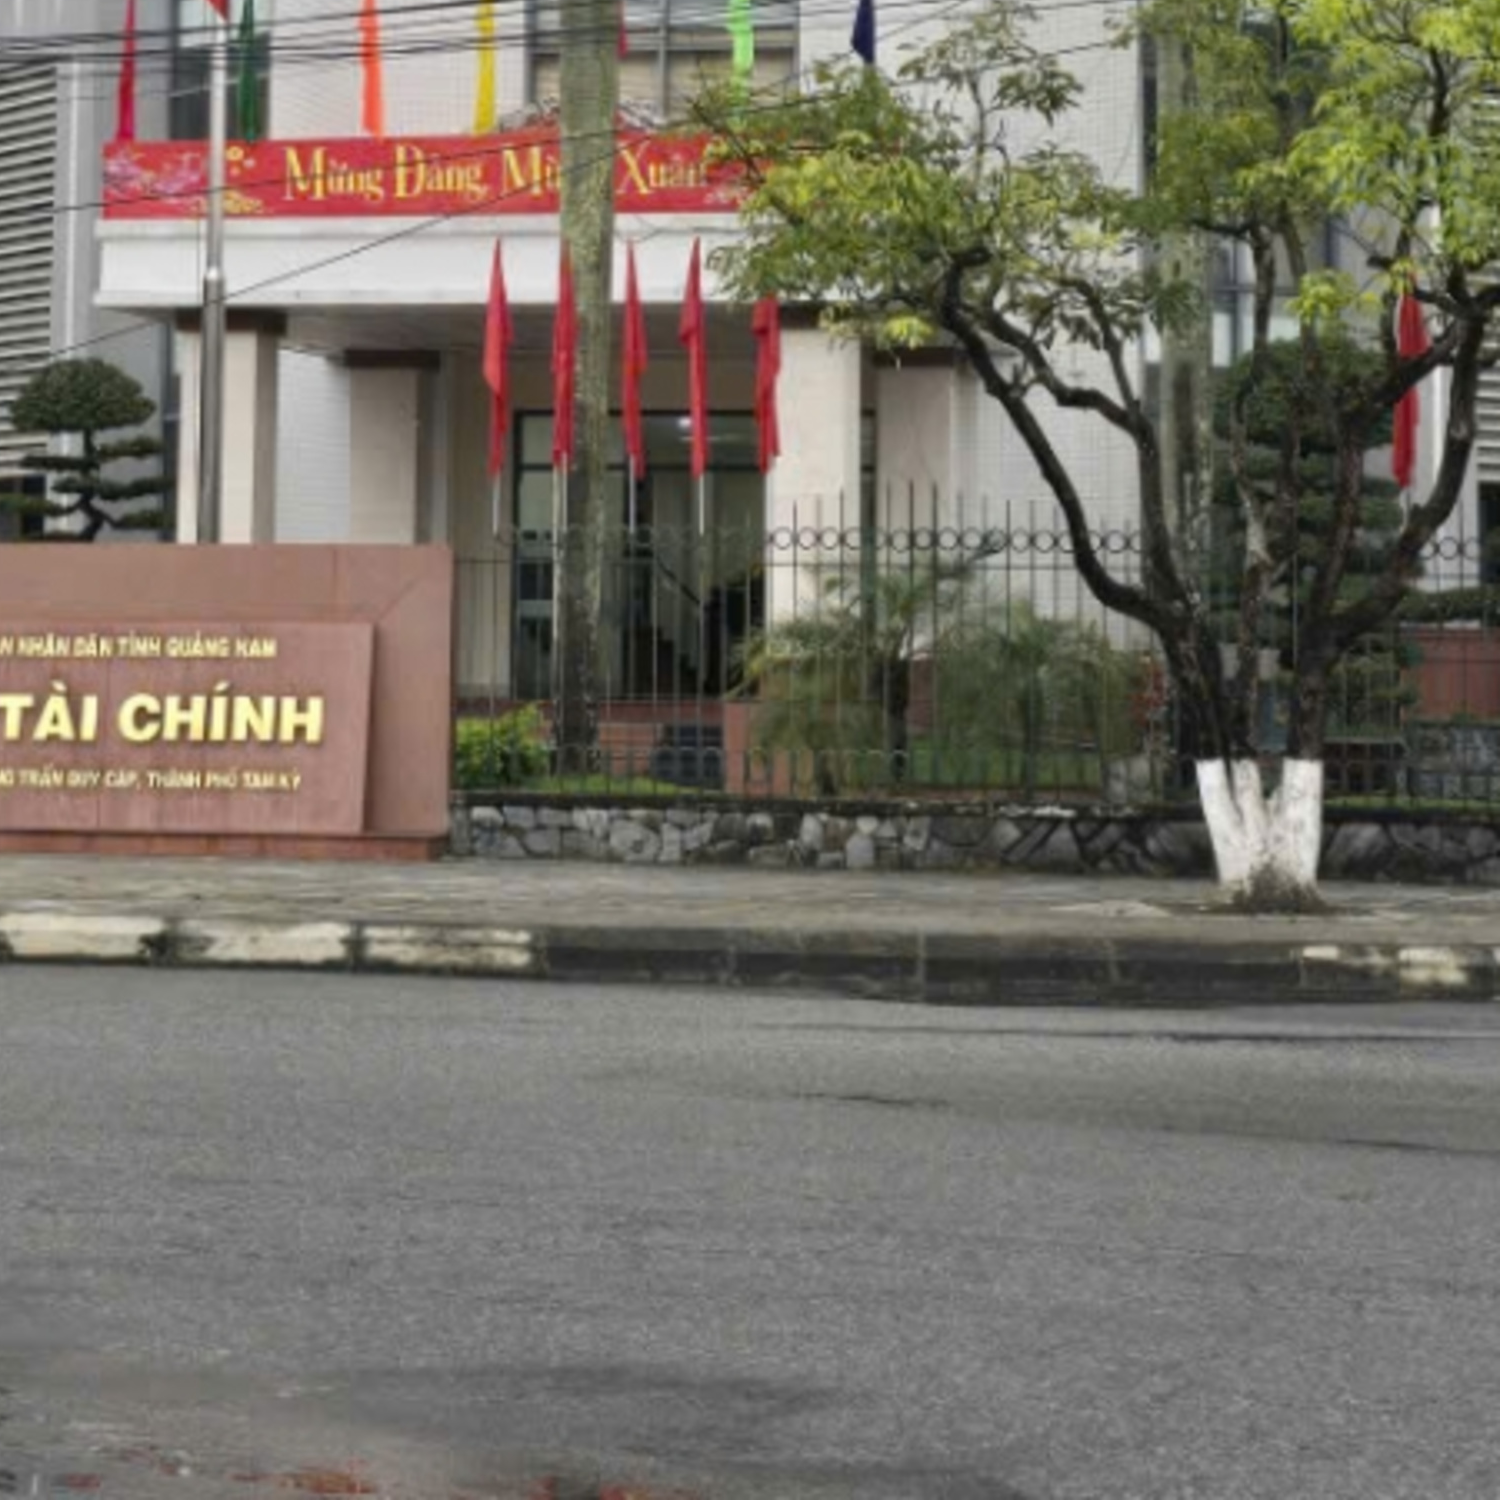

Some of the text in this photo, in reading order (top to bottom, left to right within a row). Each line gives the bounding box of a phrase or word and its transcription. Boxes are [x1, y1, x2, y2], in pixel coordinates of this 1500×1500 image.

[19, 632, 71, 657] NHÂN
[235, 636, 278, 658] NAM
[118, 681, 324, 744] CHÍNH
